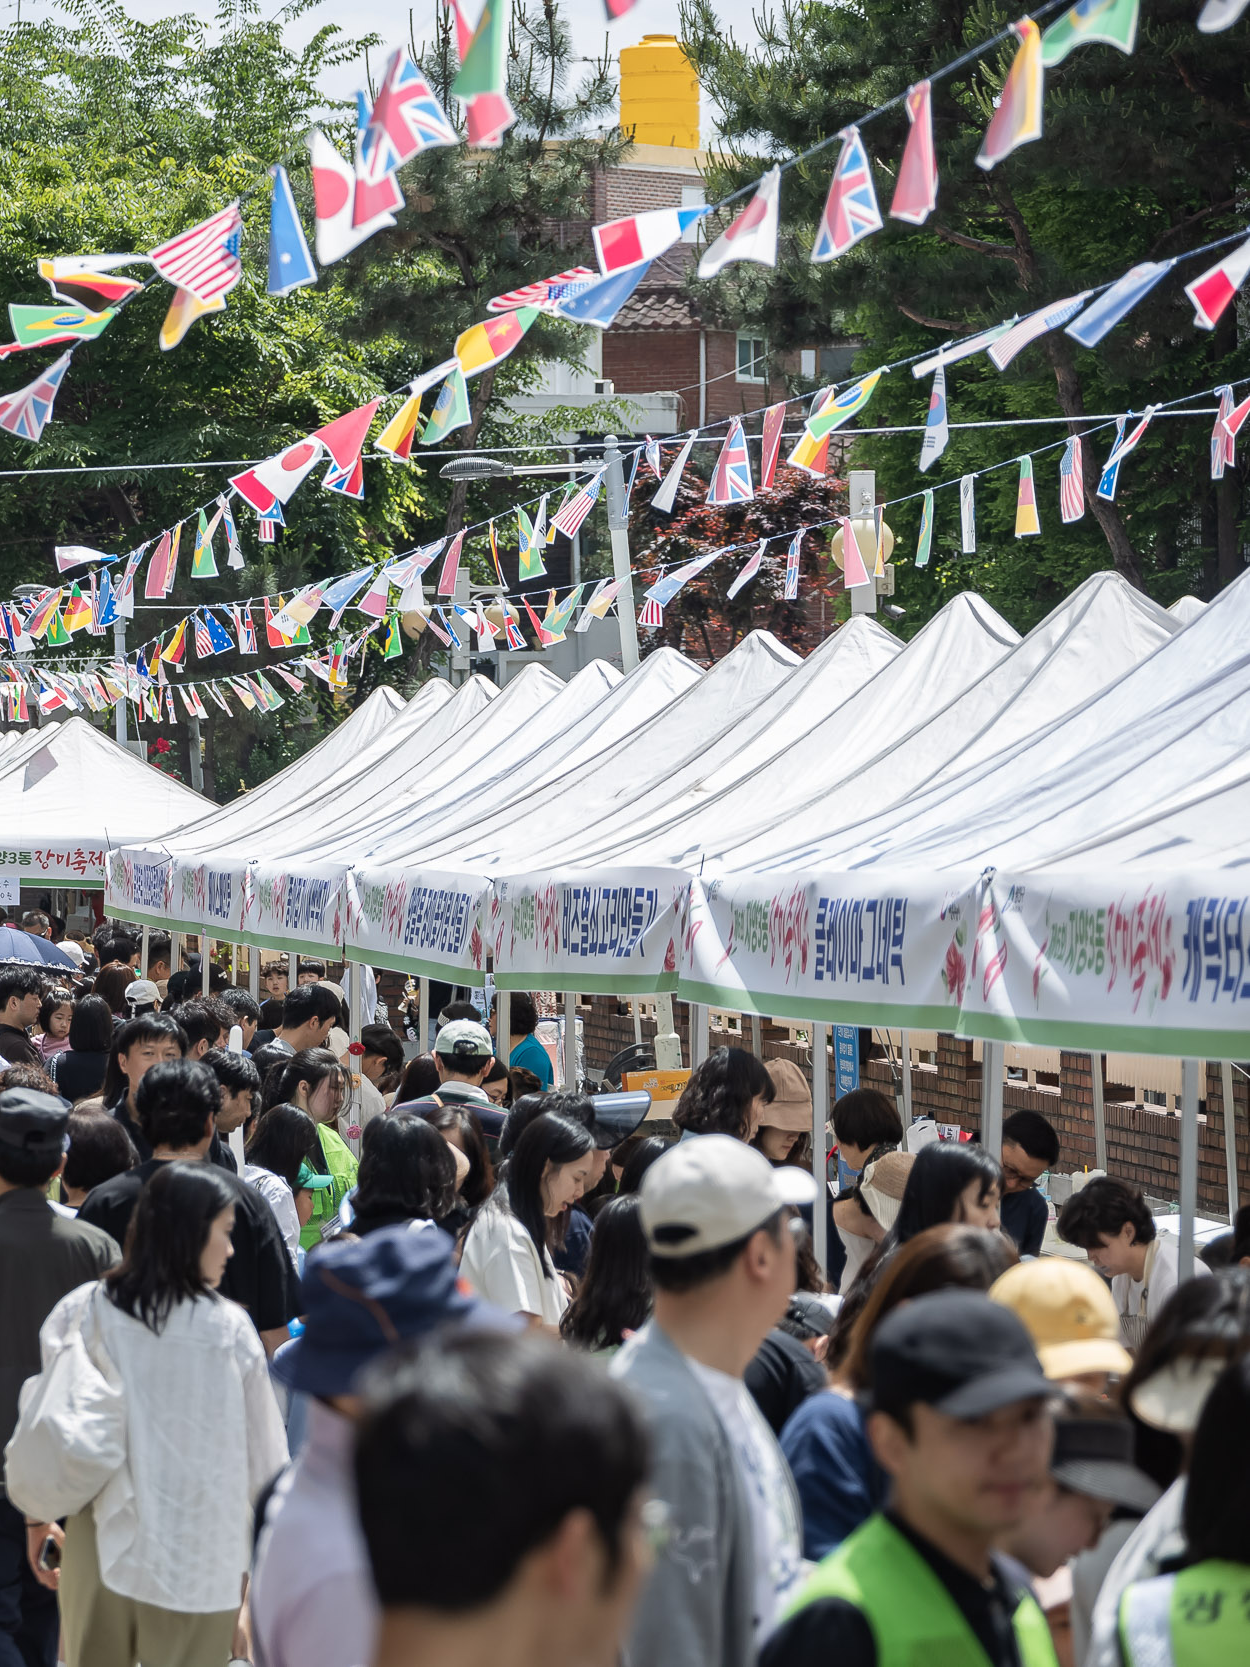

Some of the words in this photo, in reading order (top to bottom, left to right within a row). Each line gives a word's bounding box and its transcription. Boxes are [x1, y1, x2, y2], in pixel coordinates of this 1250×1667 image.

[34, 848, 106, 876] 장미축제
[744, 900, 771, 953] 자양3동
[815, 897, 908, 985] 클레이마그네틱
[1068, 909, 1105, 976] 자양3동
